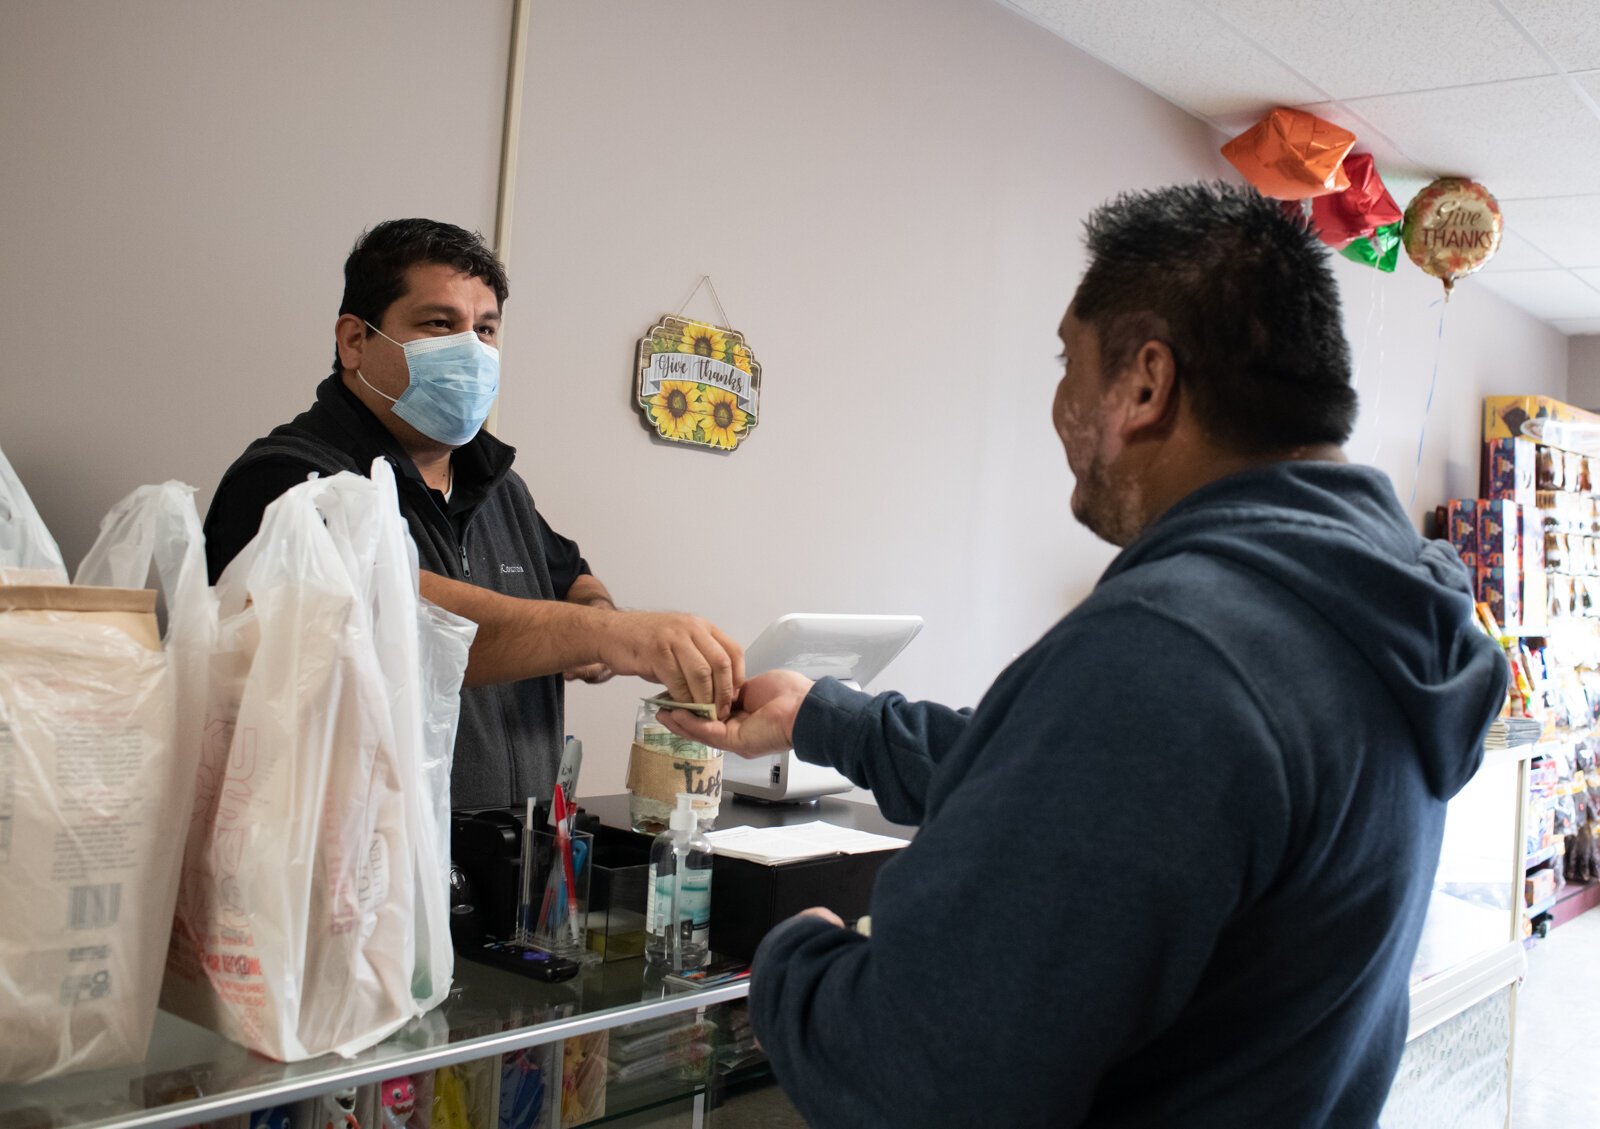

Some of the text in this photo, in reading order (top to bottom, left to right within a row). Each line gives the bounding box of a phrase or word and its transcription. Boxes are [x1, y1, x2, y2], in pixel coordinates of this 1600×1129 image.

[1436, 200, 1482, 232] Give
[1422, 229, 1494, 249] THANKS
[656, 354, 744, 393] Give thanks
[673, 761, 722, 799] Tips
